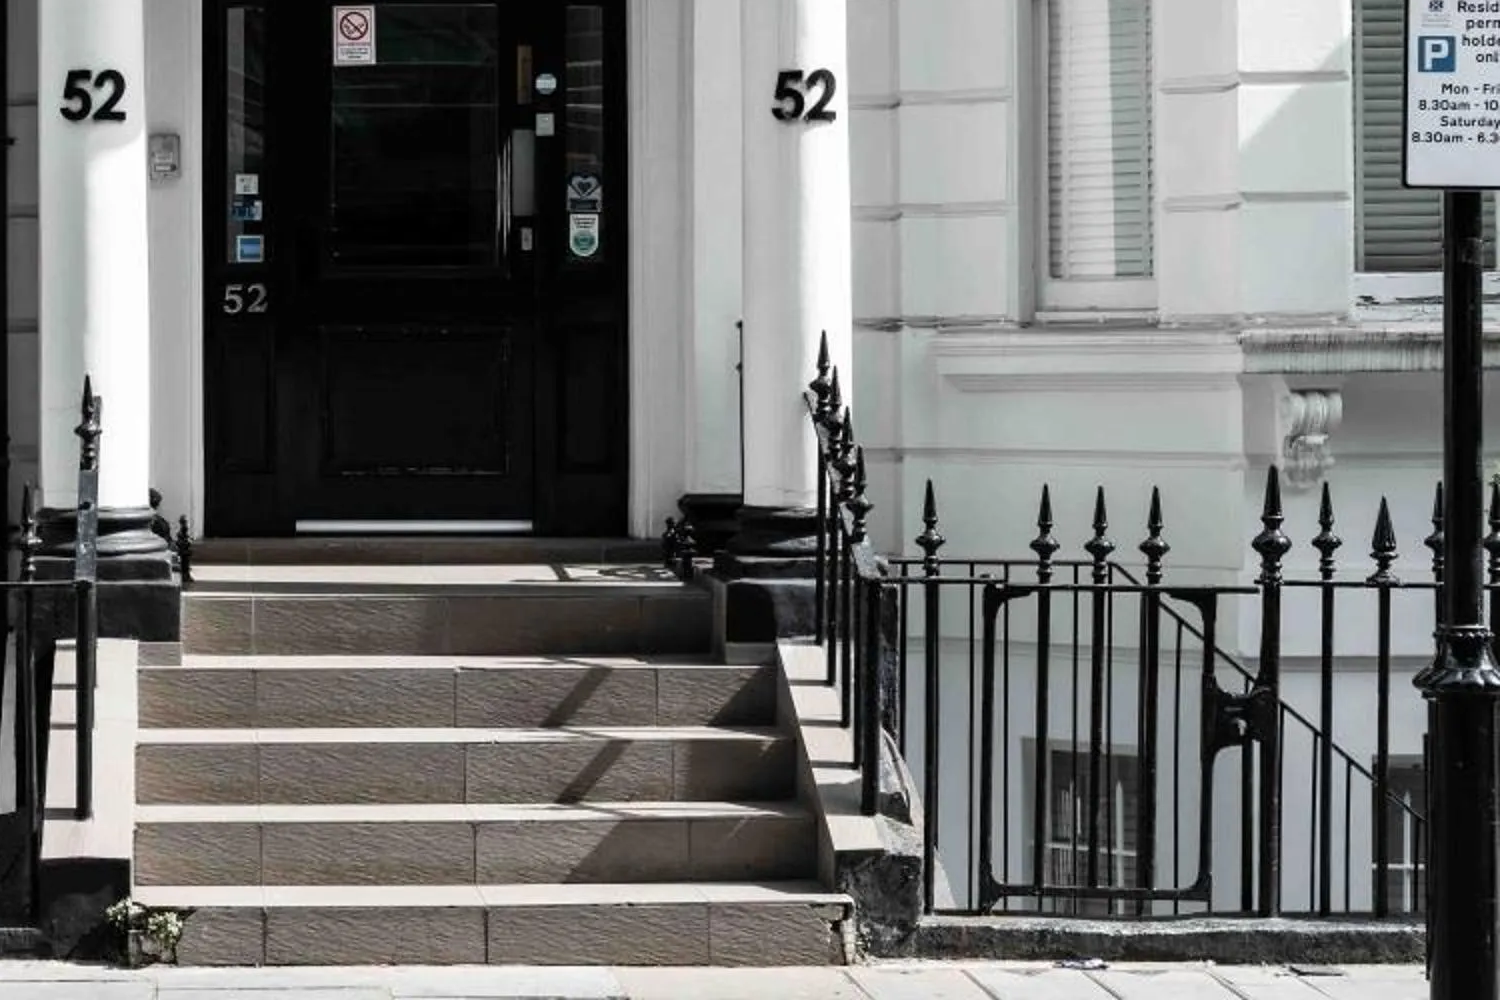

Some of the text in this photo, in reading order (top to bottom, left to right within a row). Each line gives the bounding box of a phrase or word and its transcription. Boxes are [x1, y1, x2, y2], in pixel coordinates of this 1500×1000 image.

[1424, 39, 1449, 70] P
[60, 69, 126, 122] 52
[771, 68, 836, 122] 52
[1441, 83, 1469, 95] Mon
[1419, 99, 1471, 111] 8.30am
[1441, 115, 1500, 129] Saturday
[1411, 131, 1463, 143] 8.30am
[223, 283, 268, 315] 52
